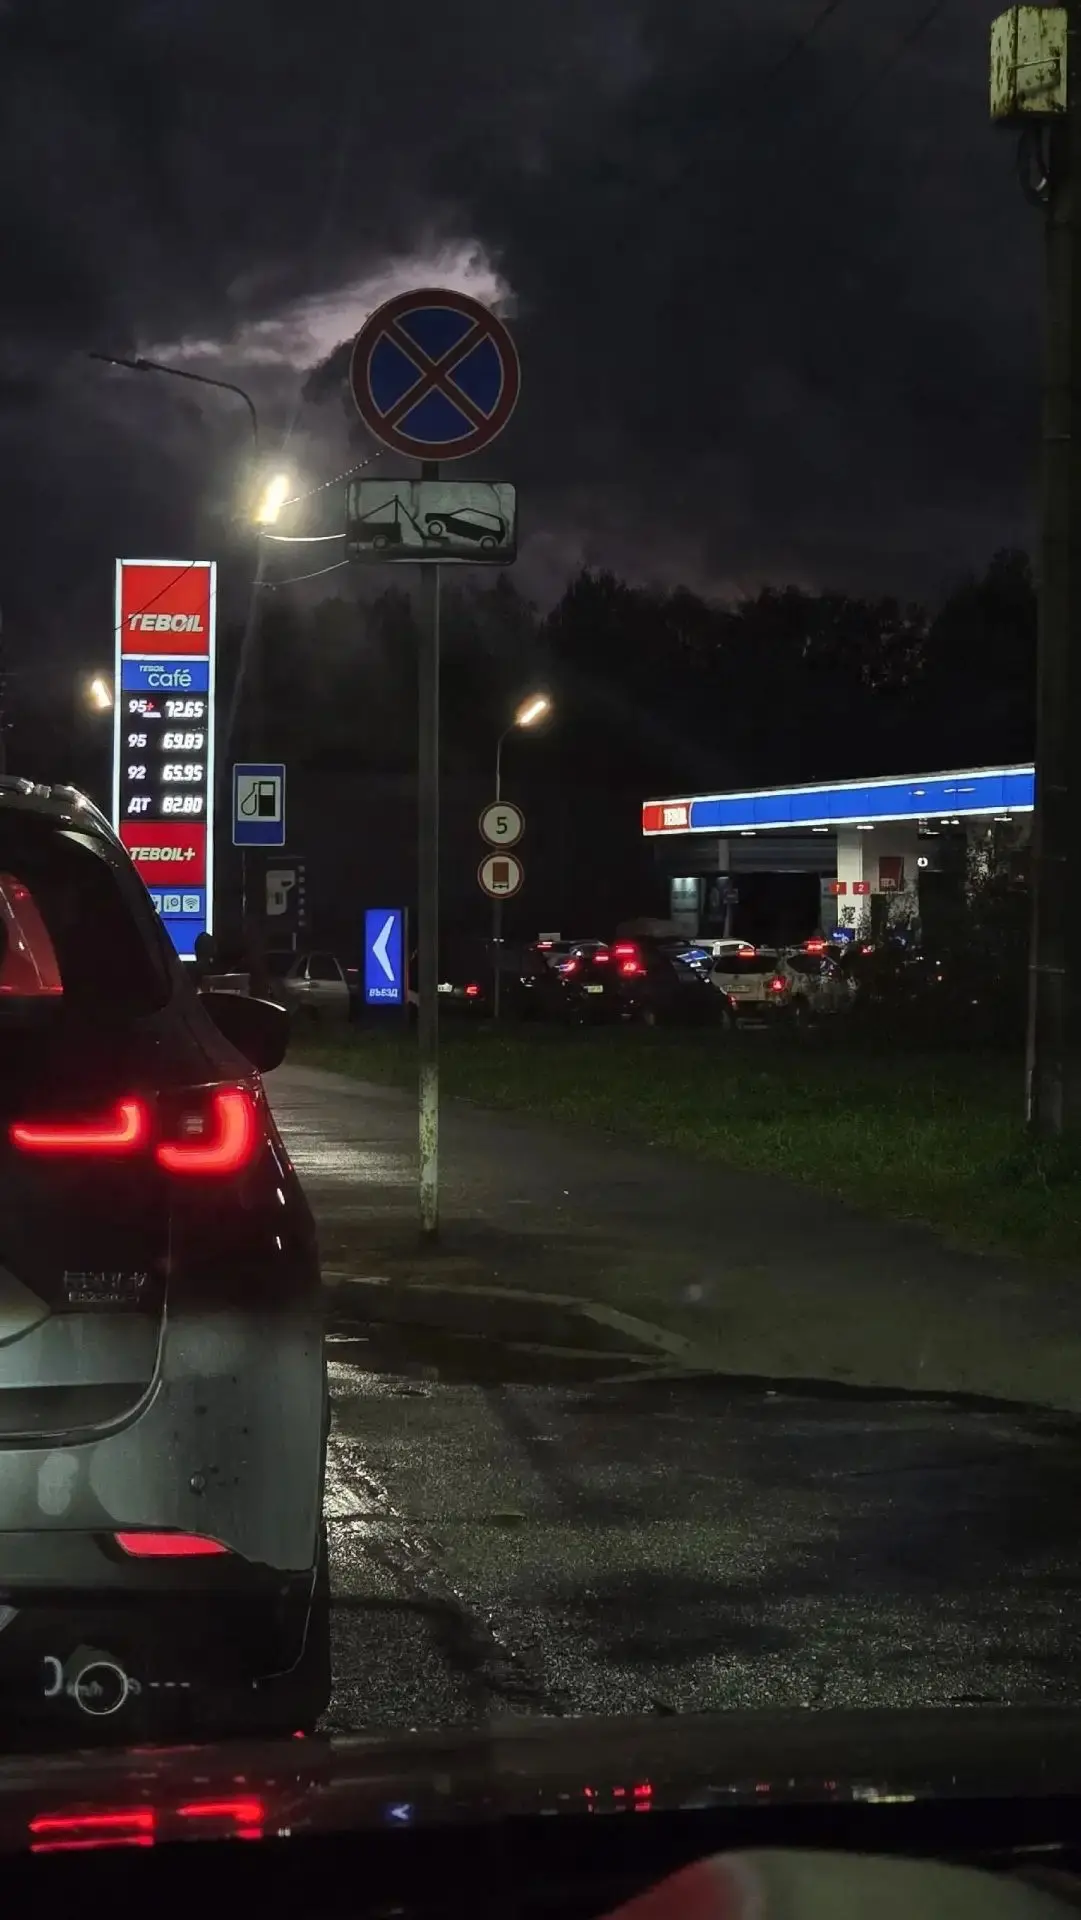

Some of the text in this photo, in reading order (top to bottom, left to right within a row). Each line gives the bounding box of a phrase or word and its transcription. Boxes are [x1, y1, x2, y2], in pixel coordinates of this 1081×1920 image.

[128, 613, 204, 632] TEBOIL
[148, 669, 192, 687] café
[128, 733, 147, 747] 95
[128, 765, 146, 779] 92
[127, 796, 152, 813] ДТ
[496, 816, 508, 835] 5
[857, 883, 865, 893] 2
